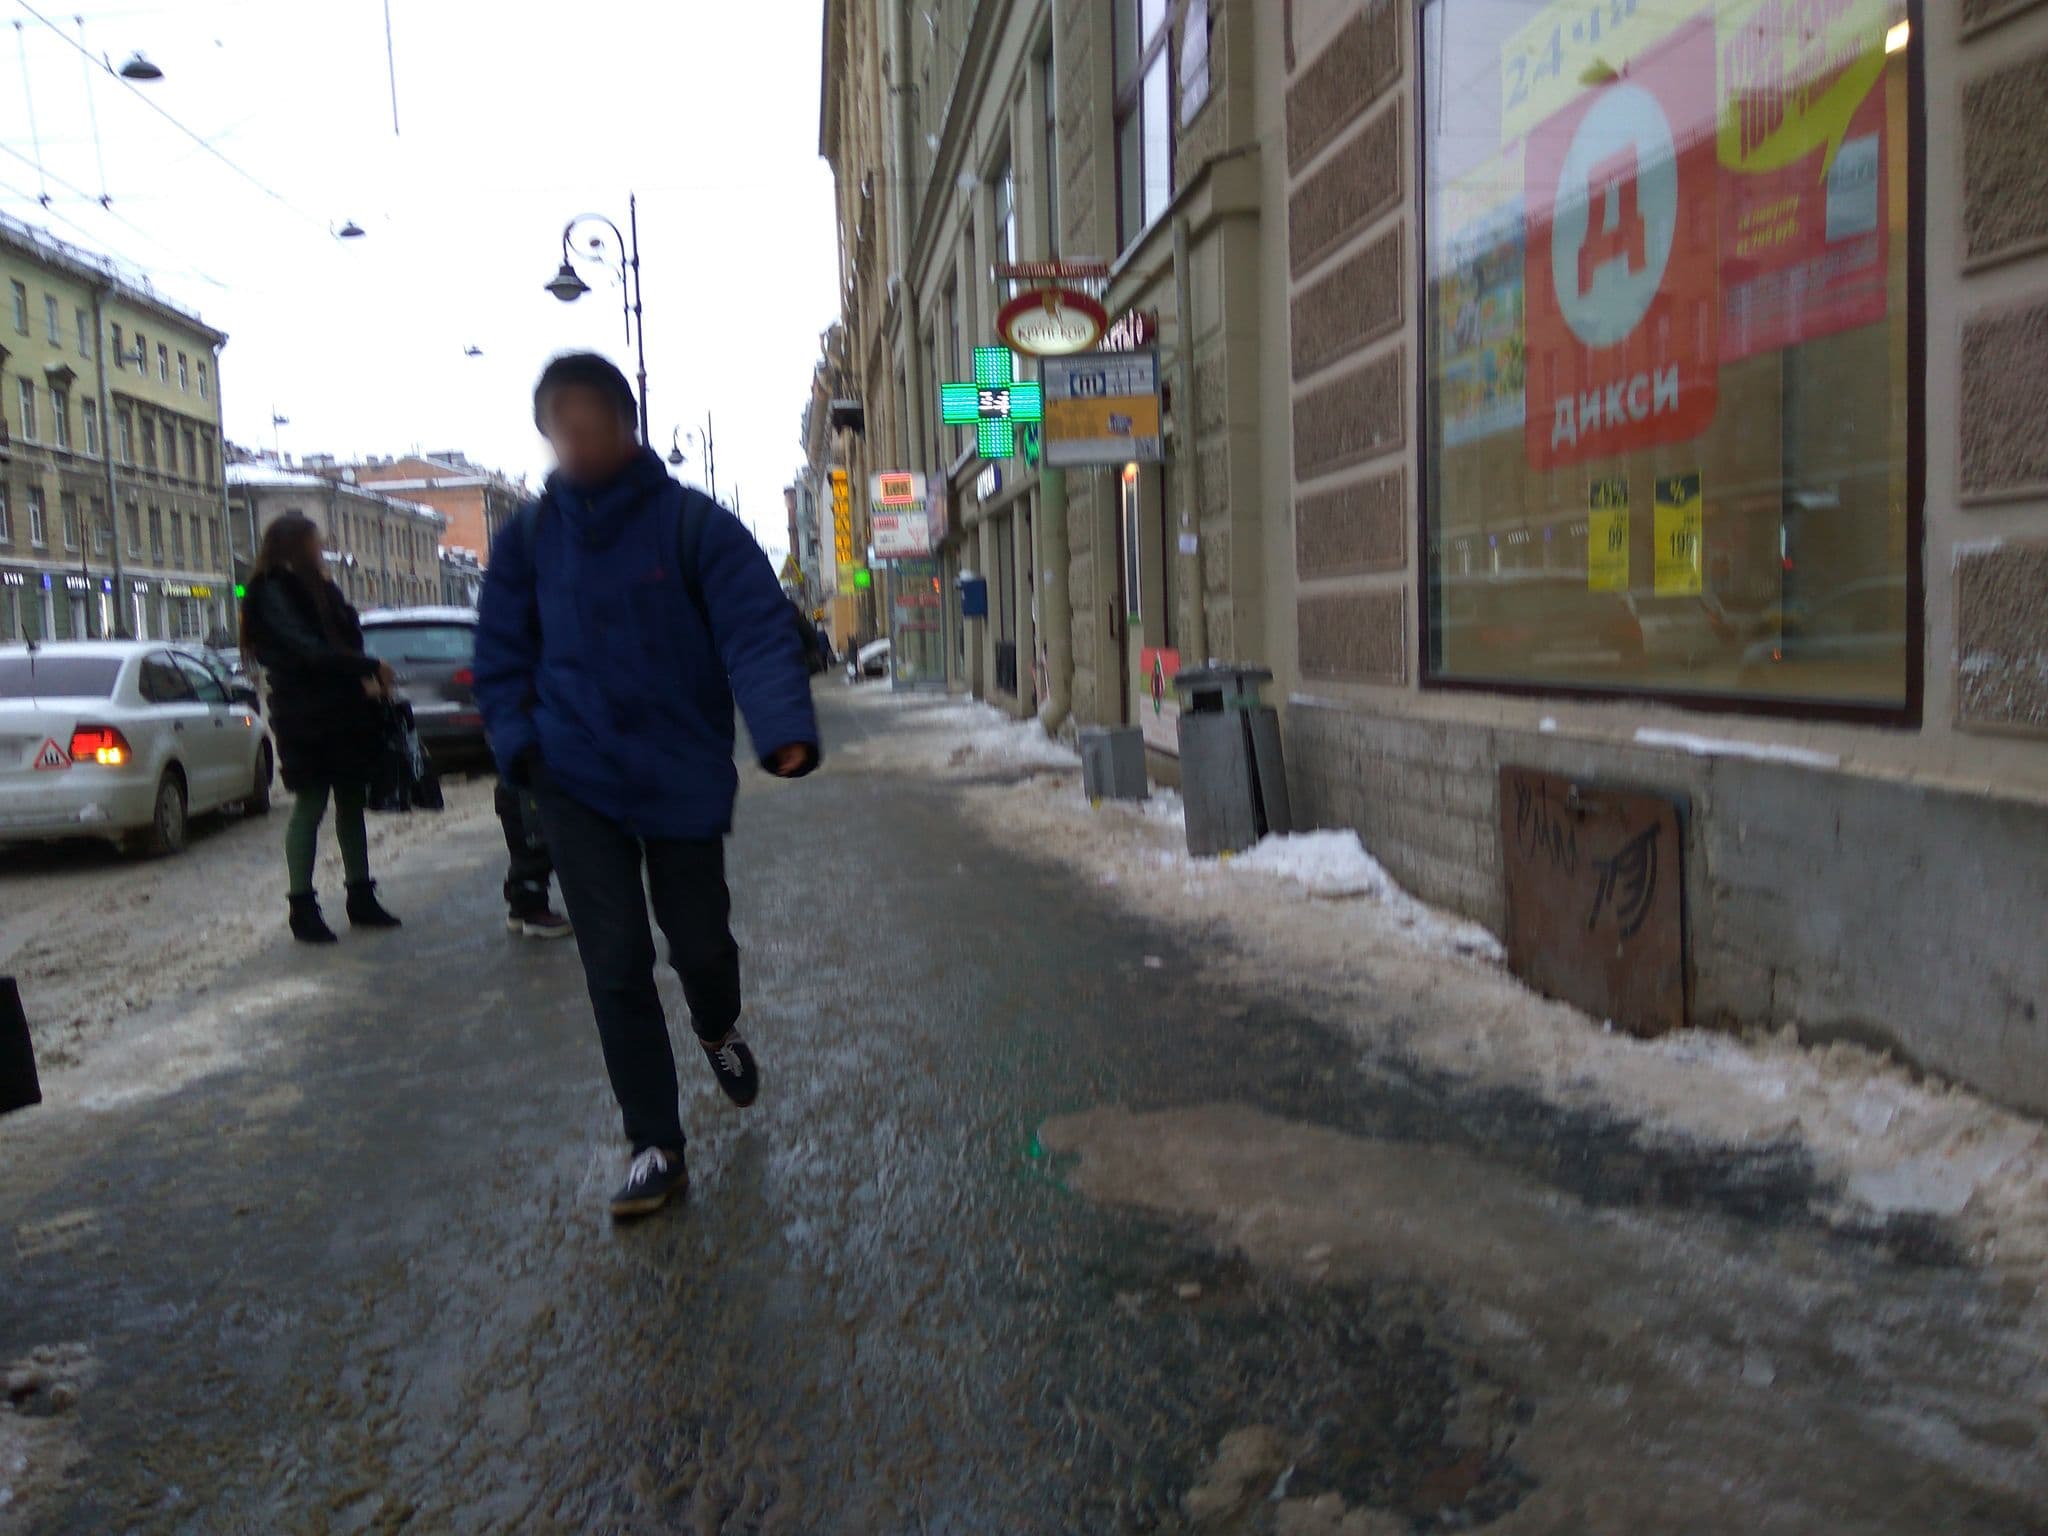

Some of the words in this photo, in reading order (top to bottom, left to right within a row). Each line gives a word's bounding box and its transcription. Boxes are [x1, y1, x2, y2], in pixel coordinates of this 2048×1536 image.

[1506, 24, 1562, 110] 24
[1577, 140, 1648, 298] Д
[1551, 360, 1680, 451] ДИКСИ
